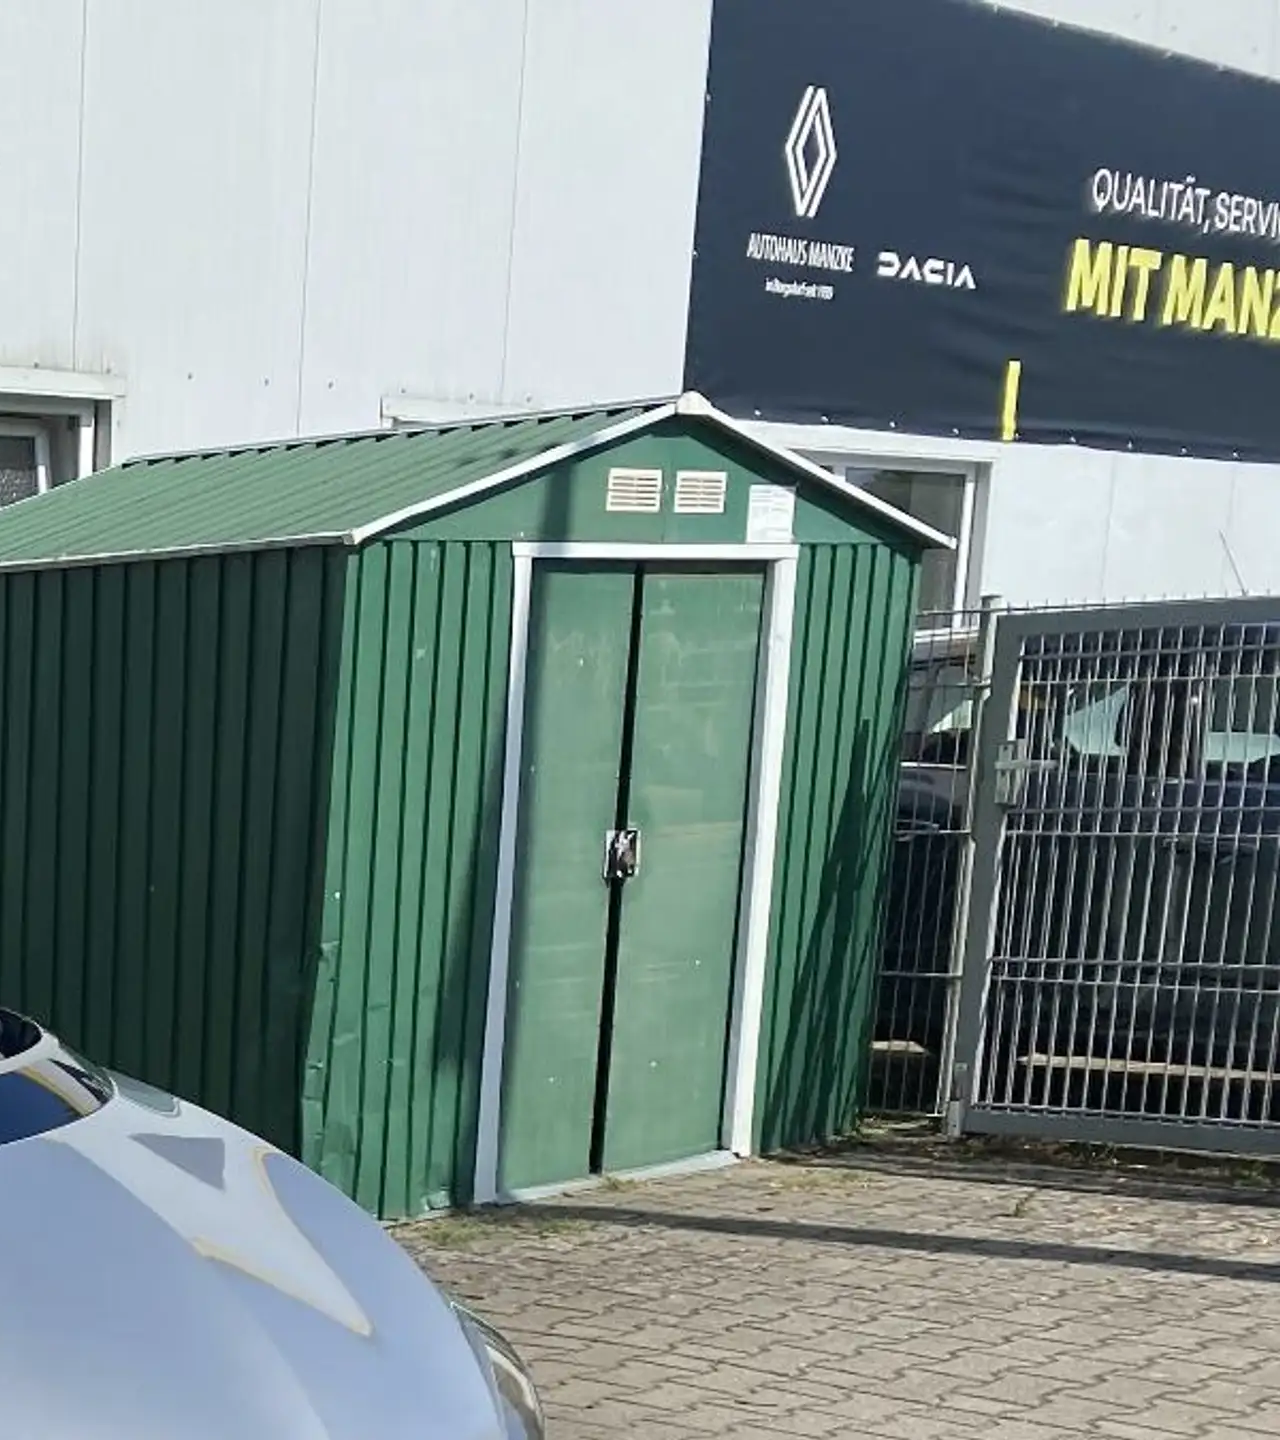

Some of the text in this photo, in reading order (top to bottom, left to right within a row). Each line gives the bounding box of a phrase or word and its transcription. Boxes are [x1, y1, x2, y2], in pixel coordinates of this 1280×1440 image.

[1092, 168, 1280, 239] QUALITÄT, SERVI
[746, 233, 855, 273] AUTOHAUS MANZKE
[877, 251, 977, 290] DACIA
[1066, 238, 1163, 321] MIT
